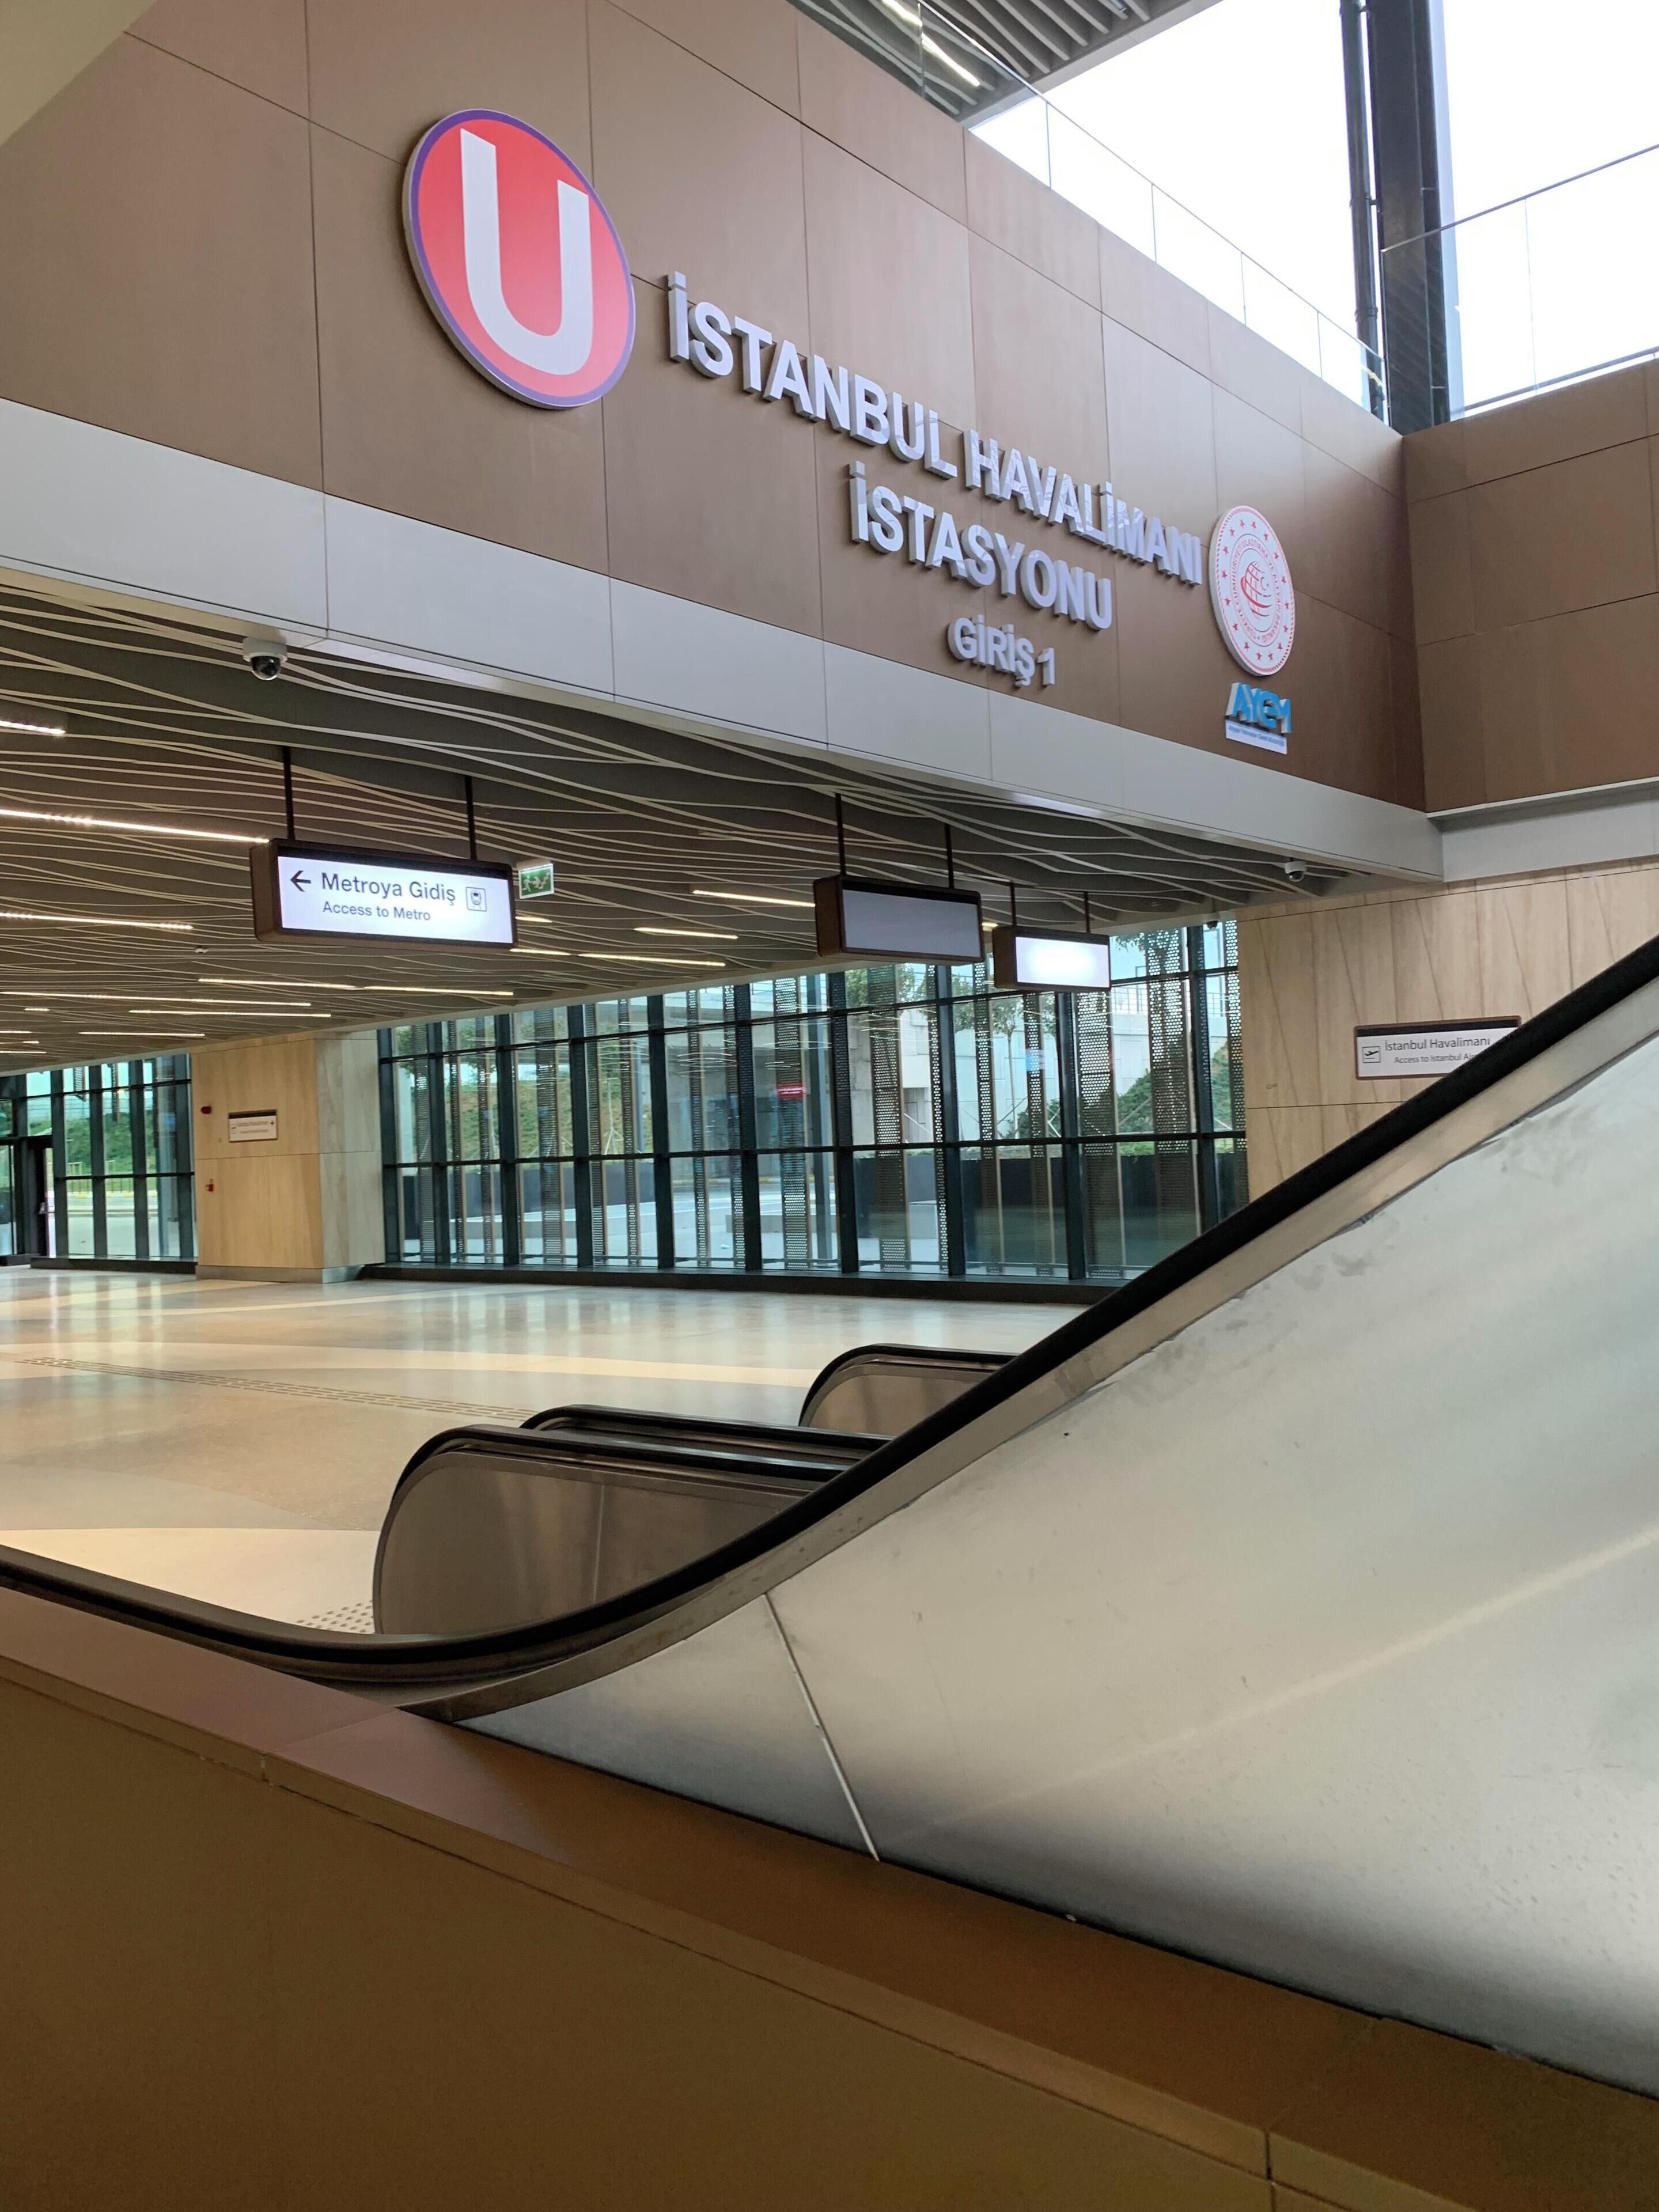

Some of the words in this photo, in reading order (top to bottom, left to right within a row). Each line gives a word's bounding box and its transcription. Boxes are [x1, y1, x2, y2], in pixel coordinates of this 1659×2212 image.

[460, 128, 593, 375] U
[668, 271, 957, 479] İSTANBUL
[963, 429, 1203, 586] HAVALİMANI
[849, 461, 1113, 630] İSTASYONU
[948, 614, 1035, 686] GİRİŞ
[1037, 647, 1055, 685] 1
[321, 872, 403, 899] Metroya
[409, 881, 456, 906] Gidiş
[322, 900, 372, 916] Access
[376, 906, 389, 917] to
[393, 908, 431, 921] Metro
[1385, 1040, 1427, 1051] İstanbul
[1430, 1037, 1490, 1048] Havalimanı
